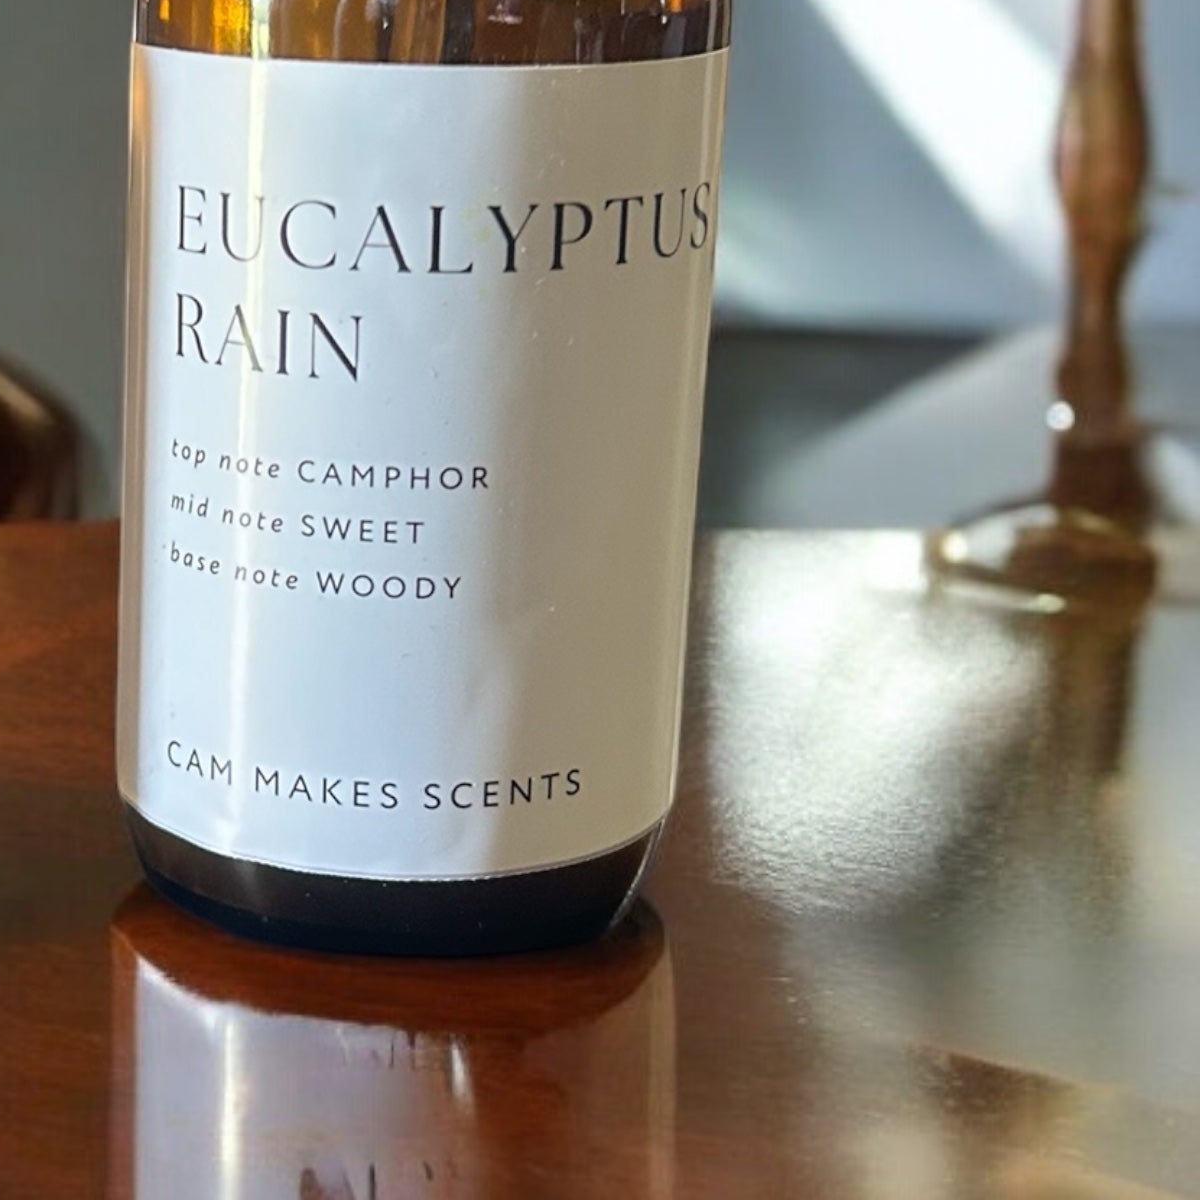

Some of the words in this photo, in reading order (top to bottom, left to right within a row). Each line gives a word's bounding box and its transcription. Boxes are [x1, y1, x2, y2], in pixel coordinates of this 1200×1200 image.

[176, 181, 712, 275] EUCALYPTUS
[175, 292, 364, 383] RAIN
[171, 438, 206, 469] top
[218, 454, 281, 479] note
[297, 459, 489, 491] CAMPHOR
[170, 494, 210, 518] mid
[221, 508, 284, 534] note
[300, 514, 425, 545] SWEET
[170, 540, 221, 576] base
[234, 566, 299, 591] note
[315, 570, 462, 600] WOODY
[167, 739, 232, 786] CAM
[254, 765, 399, 810] MAKES
[423, 768, 582, 811] SCENTS
